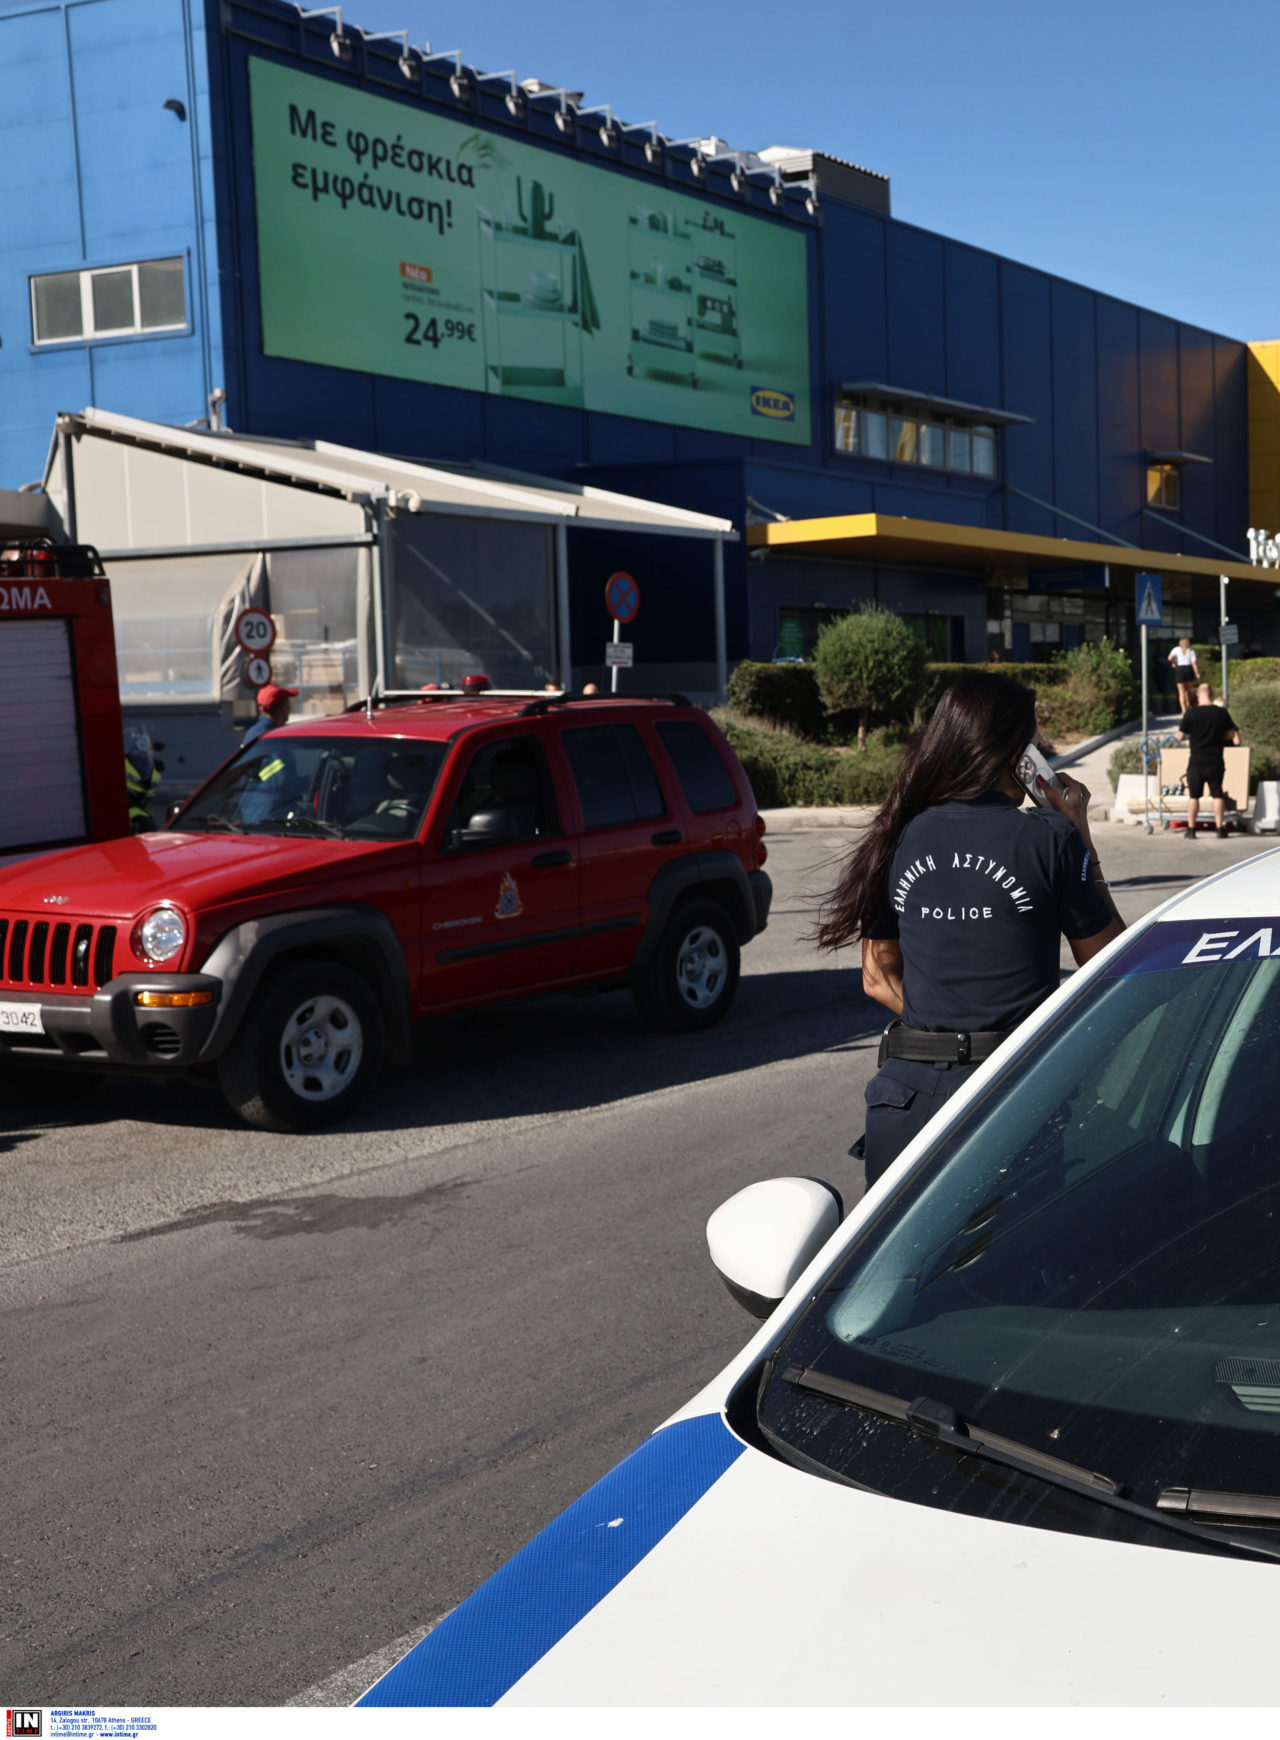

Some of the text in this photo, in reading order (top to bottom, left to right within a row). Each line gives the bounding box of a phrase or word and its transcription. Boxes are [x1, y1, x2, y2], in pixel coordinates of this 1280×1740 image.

[288, 102, 476, 189] Με φρέσκια
[291, 162, 453, 236] εμφάνιση!
[403, 312, 477, 349] 24,99€
[755, 394, 791, 412] IKEA
[244, 620, 268, 639] 20
[893, 852, 1034, 913] ΕΛΛΗΝΙΚΗ ΑΣΤΥΝΟΜΙΑ
[921, 907, 992, 920] POLICE
